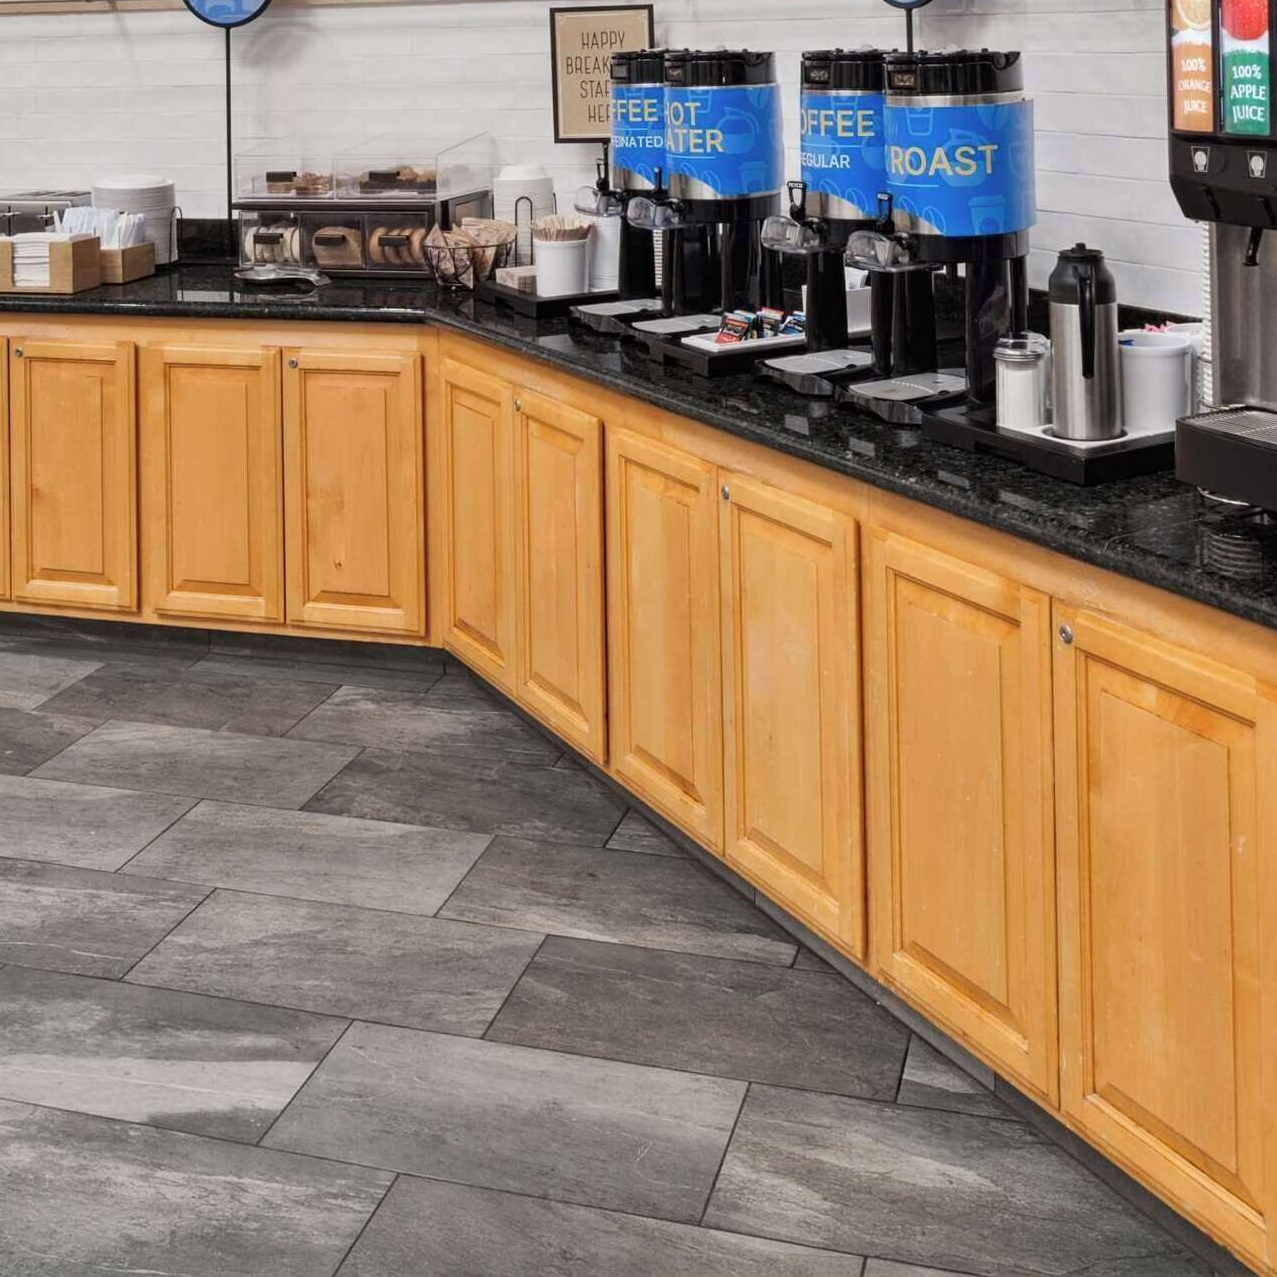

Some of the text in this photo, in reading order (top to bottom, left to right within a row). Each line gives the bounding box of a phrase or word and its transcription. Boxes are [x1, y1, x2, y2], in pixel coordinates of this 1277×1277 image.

[581, 30, 626, 50] HAPPY
[566, 54, 610, 75] BREAK
[1180, 57, 1207, 73] 100%
[1232, 64, 1263, 80] 100%
[1178, 79, 1212, 94] ORANGE
[1230, 84, 1267, 101] APPLE
[611, 99, 659, 122] FFEE
[1183, 99, 1208, 115] JUICE
[1232, 105, 1266, 124] JUICE
[801, 109, 875, 138] OFFEE
[666, 128, 725, 153] ATER
[801, 152, 851, 170] EGULAR
[889, 144, 999, 177] ROAST
